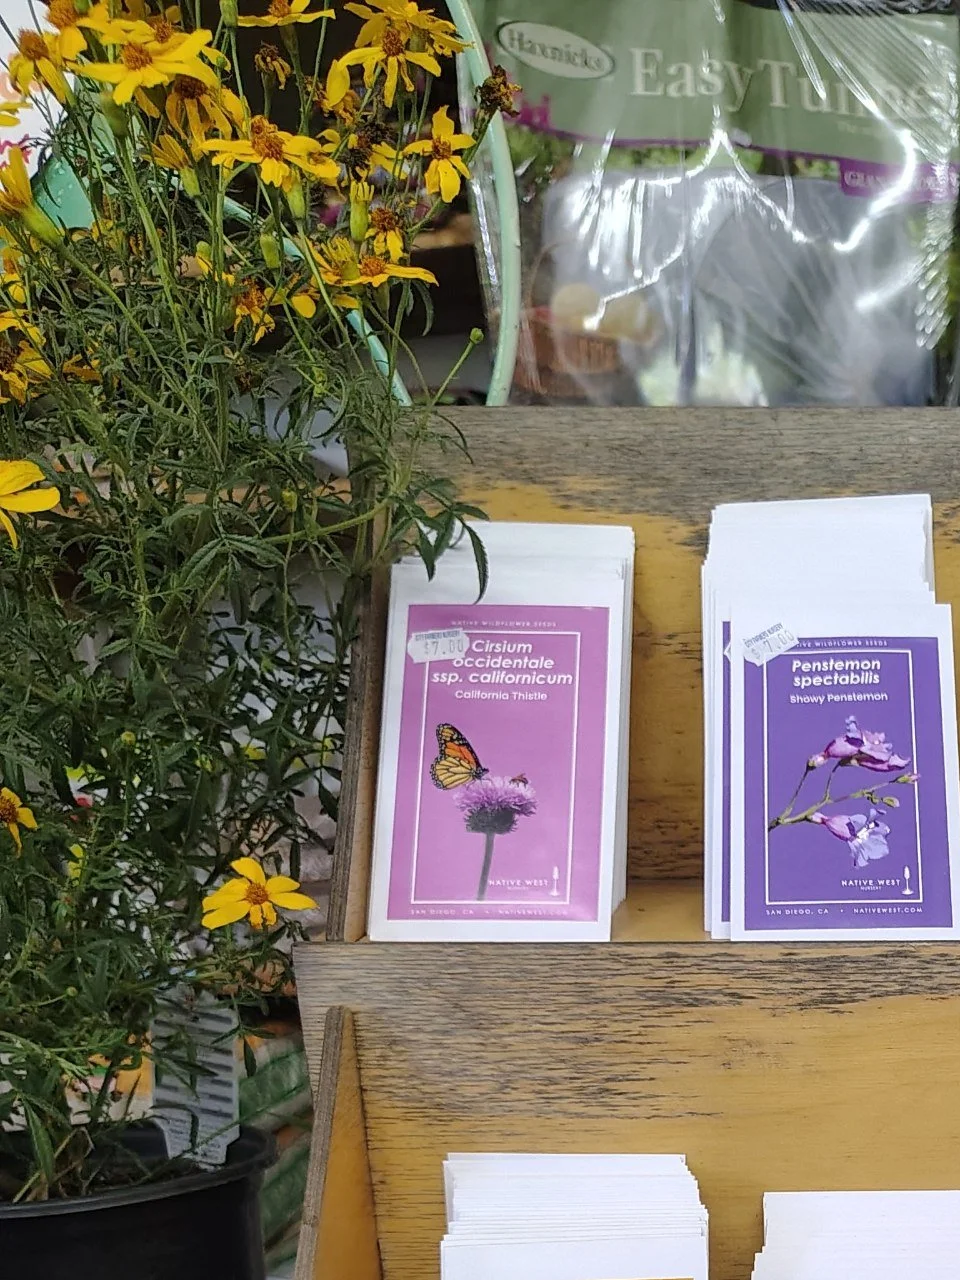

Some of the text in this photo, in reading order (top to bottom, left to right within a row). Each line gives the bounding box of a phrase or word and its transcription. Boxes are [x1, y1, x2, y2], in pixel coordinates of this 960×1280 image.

[508, 29, 602, 72] Haxnicks
[472, 640, 532, 653] Cirsium
[452, 655, 555, 669] occidentale
[792, 658, 881, 672] Penstemon
[431, 671, 573, 685] ssp. californicum
[793, 672, 880, 689] spectabilis
[455, 690, 548, 700] California Thistle
[790, 691, 888, 704] Showy Penstemon
[489, 879, 549, 887] NATIVE WEST
[841, 879, 873, 887] NATIVE
